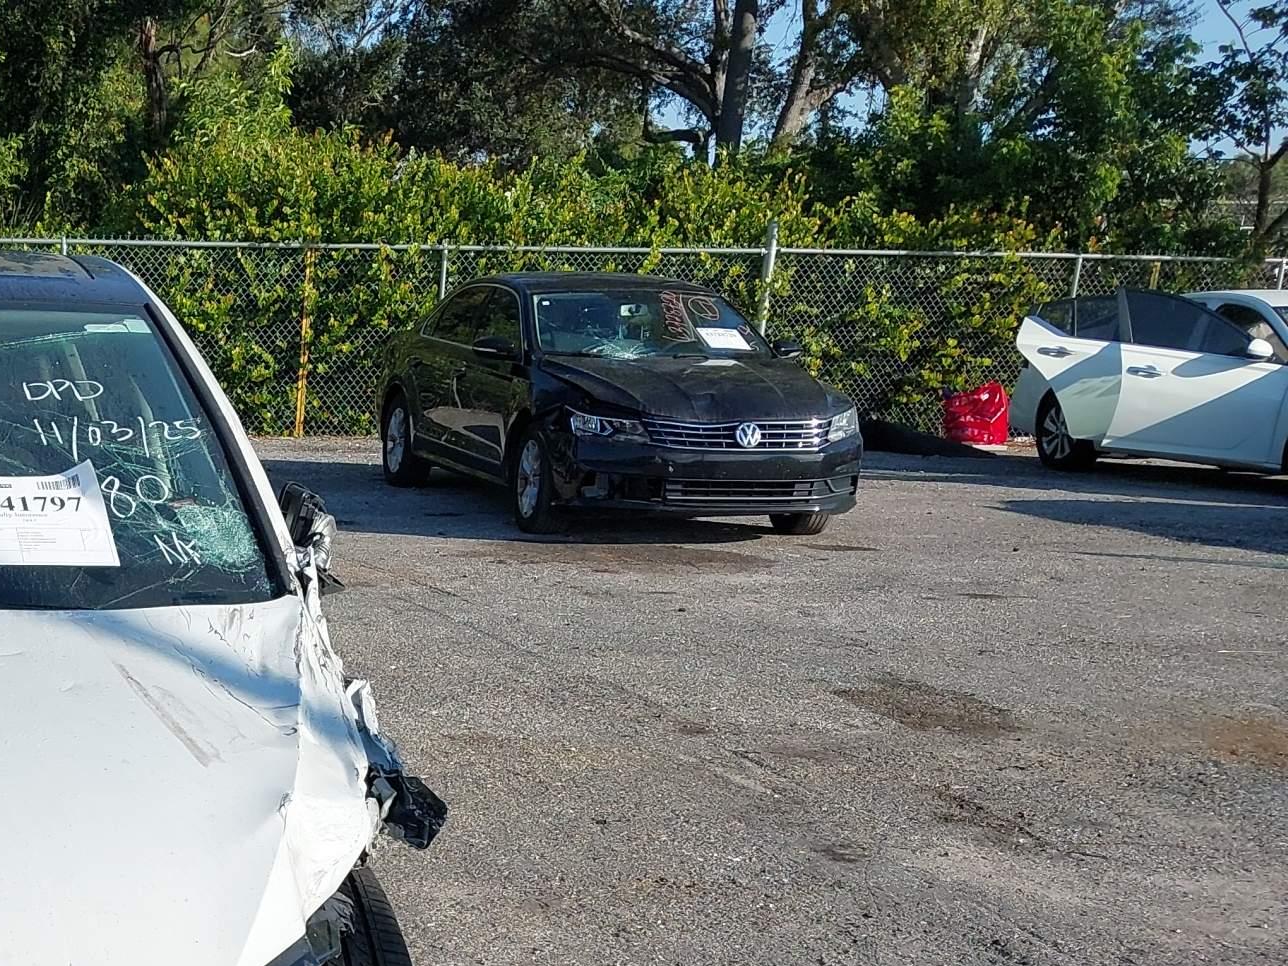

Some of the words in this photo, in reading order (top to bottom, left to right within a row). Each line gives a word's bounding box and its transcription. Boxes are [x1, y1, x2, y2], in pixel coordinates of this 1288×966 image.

[23, 379, 104, 401] DPD
[33, 416, 202, 463] 11/03/25
[101, 475, 169, 518] 80
